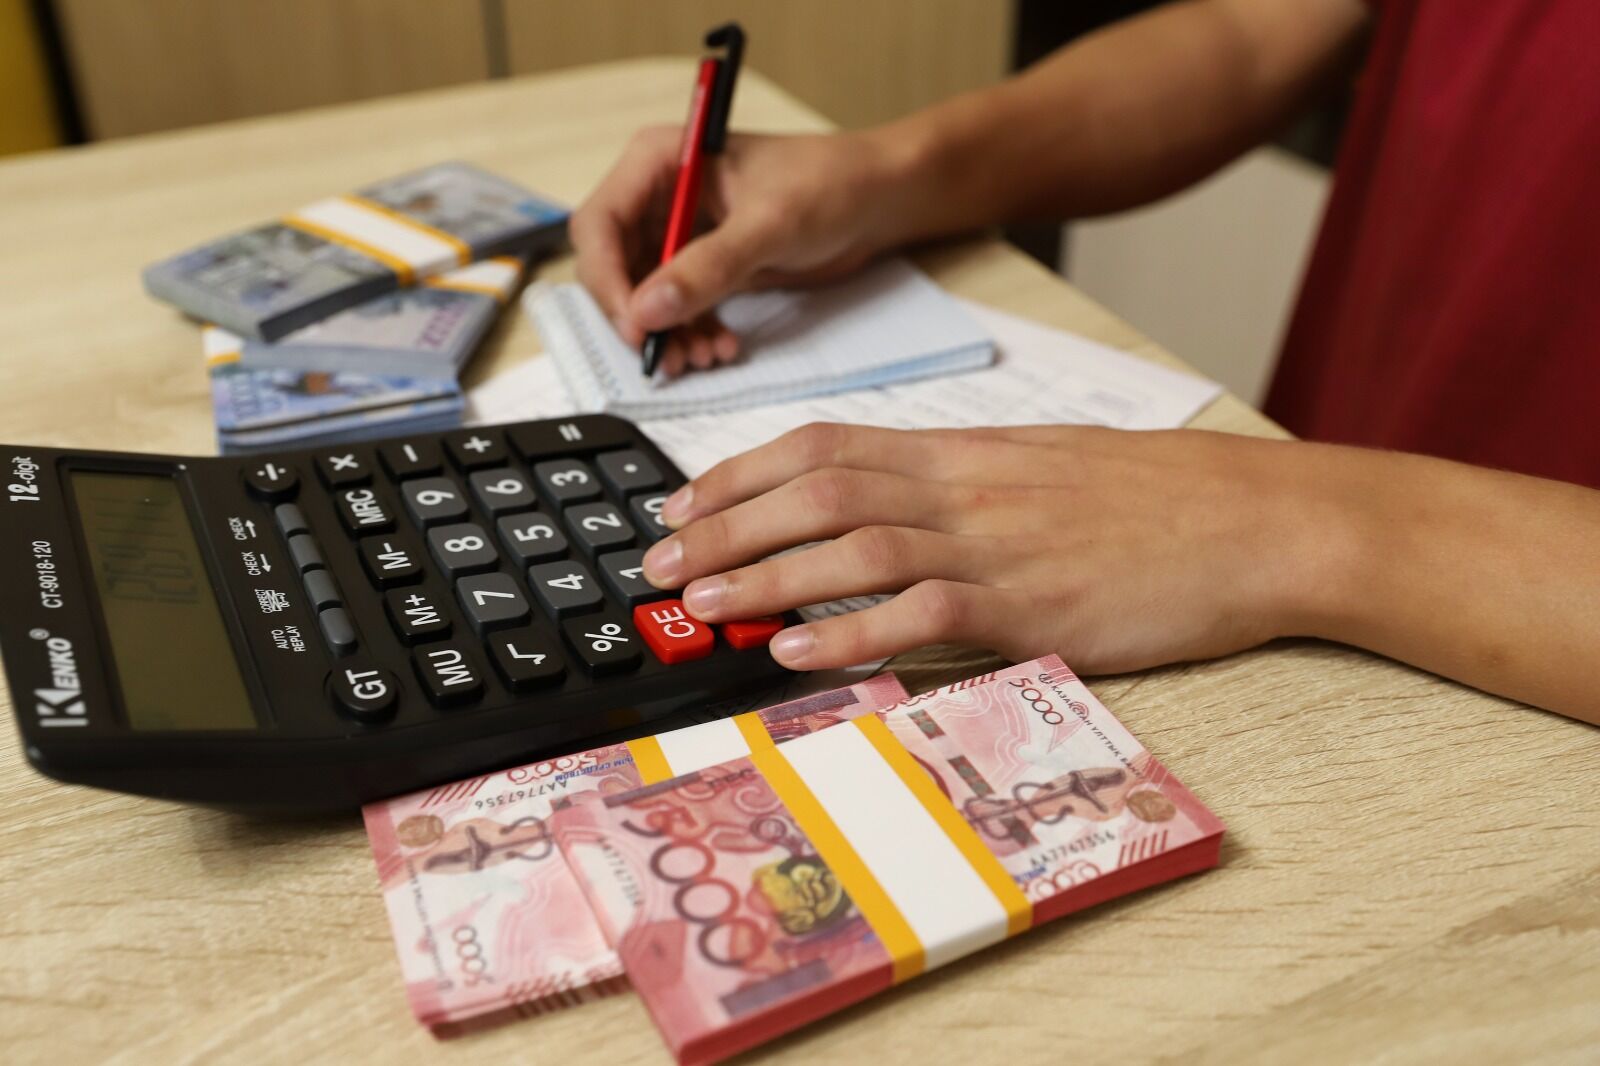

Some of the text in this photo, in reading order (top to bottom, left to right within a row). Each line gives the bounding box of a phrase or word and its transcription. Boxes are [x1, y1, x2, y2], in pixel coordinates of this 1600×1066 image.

[486, 480, 522, 494] 6
[551, 471, 587, 485] 3
[346, 490, 385, 524] MRC
[417, 491, 454, 505] 9
[228, 517, 248, 541] CHECK
[514, 525, 553, 541] 5
[583, 514, 621, 530] 2
[445, 536, 483, 552] 8
[32, 541, 62, 608] CT-9018-120
[241, 551, 262, 576] CHECK
[548, 574, 583, 589] 4
[405, 595, 440, 625] M+
[473, 591, 514, 605] 7
[650, 606, 696, 638] CE
[271, 629, 289, 649] AUTO
[284, 626, 306, 652] REPLAY
[429, 650, 473, 685] MU
[346, 670, 386, 699] GT
[1008, 677, 1063, 725] 5000
[620, 816, 768, 968] 5000
